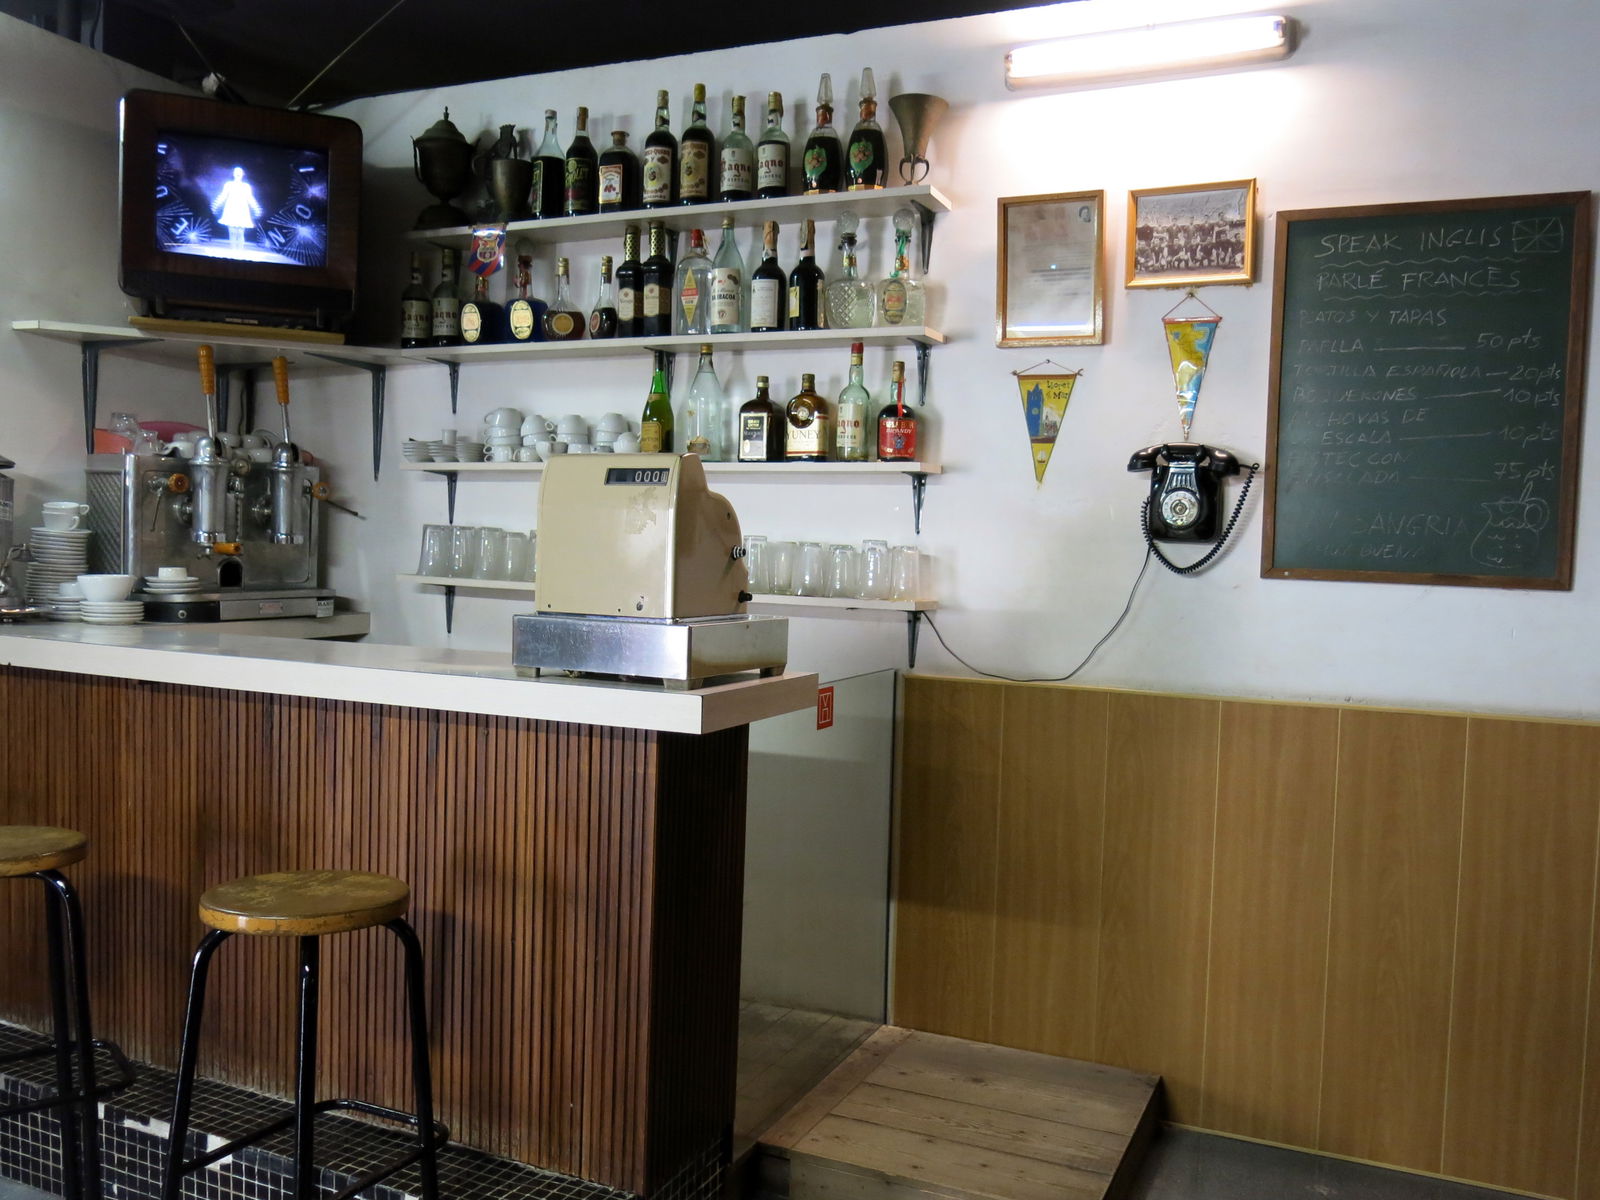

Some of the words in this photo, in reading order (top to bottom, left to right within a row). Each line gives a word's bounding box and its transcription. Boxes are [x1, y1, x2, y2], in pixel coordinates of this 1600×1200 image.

[1314, 233, 1402, 258] SPEAK
[1420, 227, 1503, 252] INGLIS
[1316, 268, 1389, 291] PARLÉ
[1366, 310, 1379, 323] Y
[1389, 308, 1448, 327] TAPAS
[1401, 407, 1430, 425] DE
[1320, 430, 1392, 445] ESCALA
[1367, 451, 1413, 466] CON
